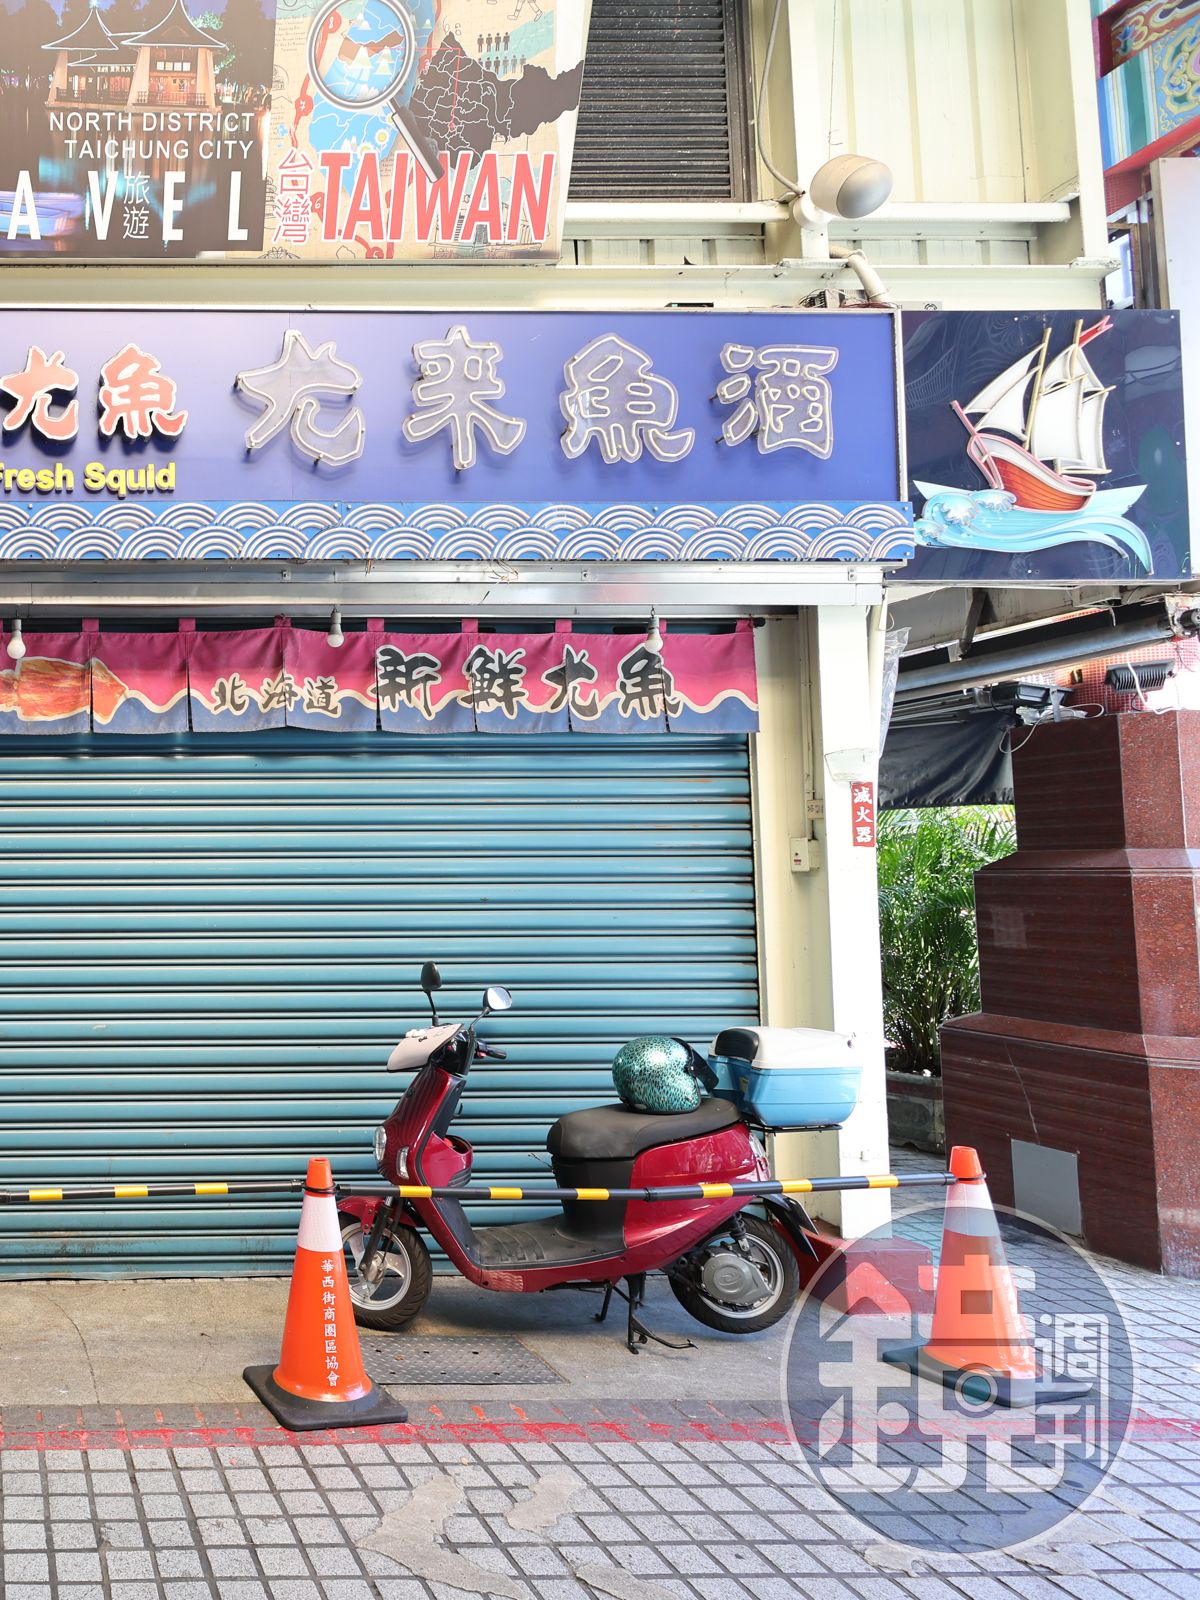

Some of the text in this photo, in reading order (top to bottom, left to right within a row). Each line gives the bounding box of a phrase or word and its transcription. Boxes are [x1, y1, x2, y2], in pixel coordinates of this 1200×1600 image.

[50, 112, 132, 132] NORTH
[142, 112, 255, 132] DISTRICT
[64, 140, 254, 159] TAICHUNG CITY
[123, 171, 150, 240] 旅遊
[274, 150, 312, 243] 台灣
[320, 152, 555, 241] TAIWAN
[84, 462, 176, 499] Squid
[211, 646, 681, 719] 北海道 新鮮尤魚
[854, 786, 873, 843] 滅火器
